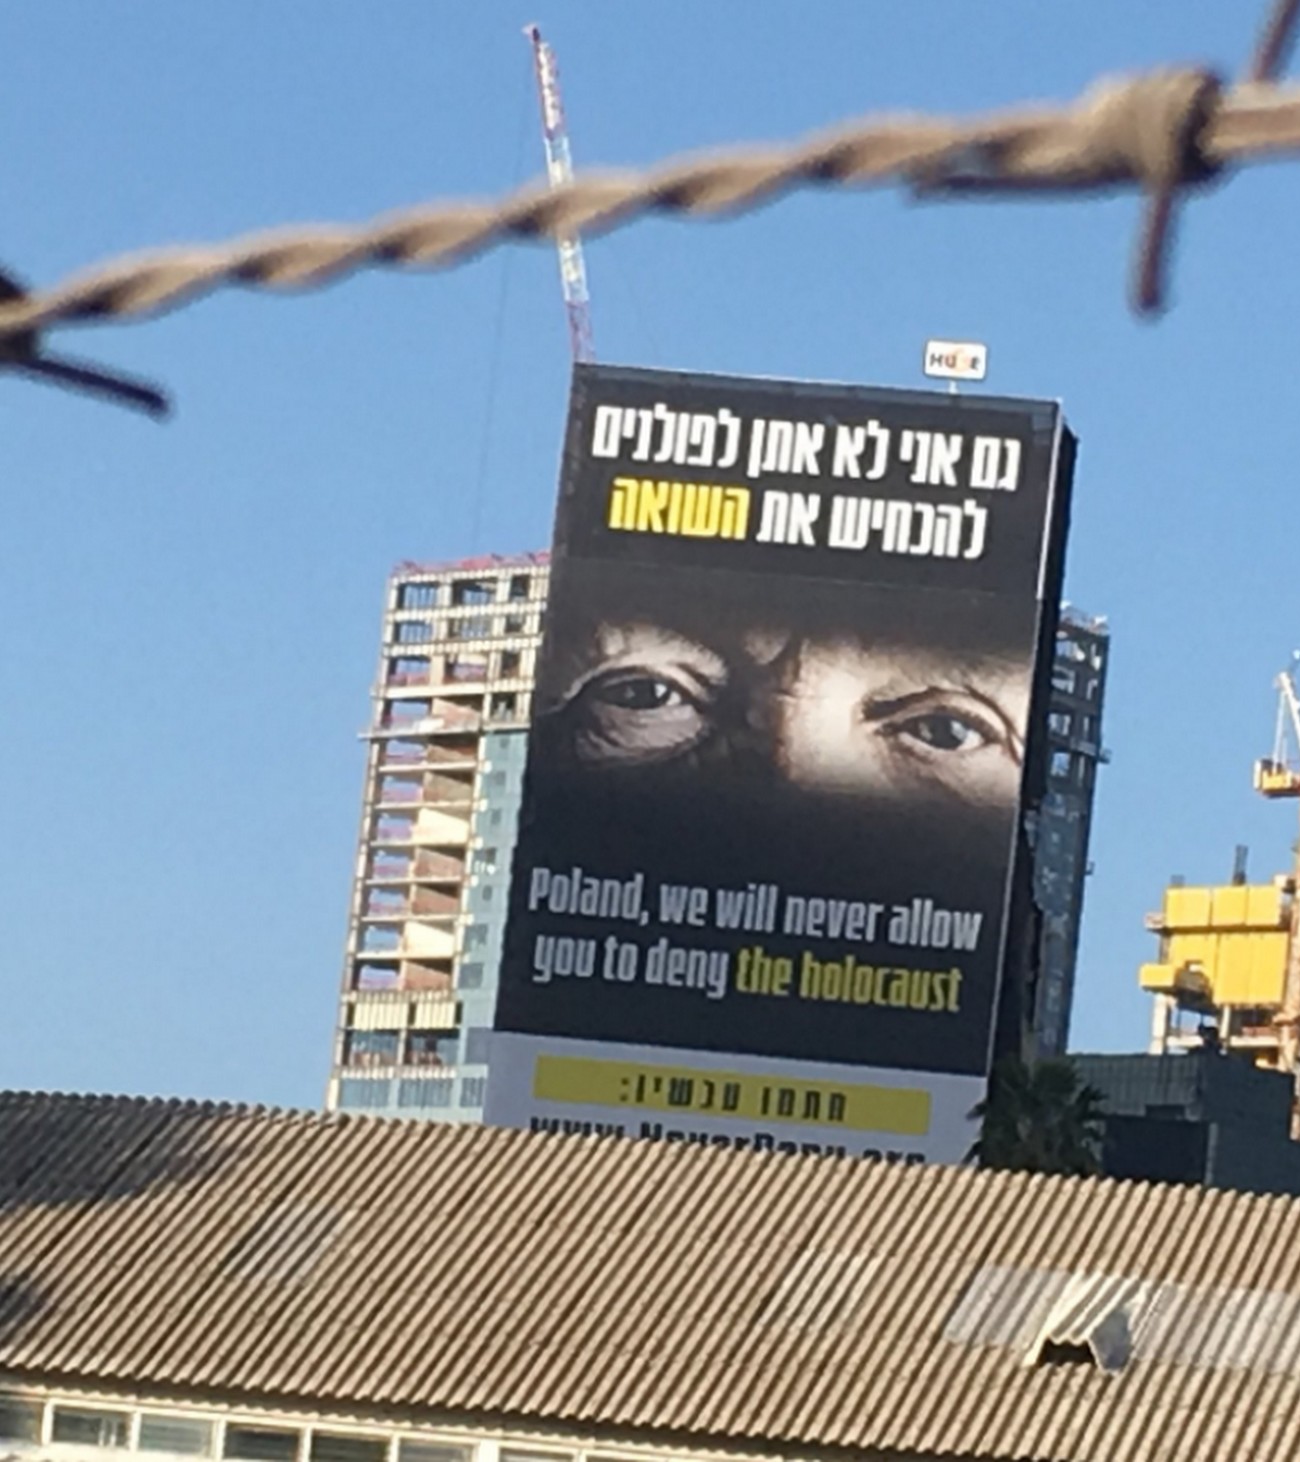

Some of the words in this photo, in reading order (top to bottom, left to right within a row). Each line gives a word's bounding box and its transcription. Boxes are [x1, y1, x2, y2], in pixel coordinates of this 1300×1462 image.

[591, 401, 739, 469] לפולנים
[746, 416, 825, 478] אתן
[831, 420, 889, 481] לא
[899, 427, 964, 487] אני
[969, 435, 1022, 492] גם
[608, 477, 750, 540] השואה
[756, 489, 819, 546] את
[827, 495, 988, 559] להכחיש
[528, 866, 649, 928] Poland,
[658, 885, 709, 927] we
[715, 882, 779, 935] will
[783, 894, 884, 943] never
[888, 897, 983, 952] allow
[532, 932, 598, 984] you
[604, 935, 638, 981] to
[645, 937, 729, 999] deny
[736, 945, 792, 998] the
[800, 951, 963, 1013] holocaust
[619, 1074, 741, 1112] עכשיו:
[760, 1085, 847, 1123] חתמו
